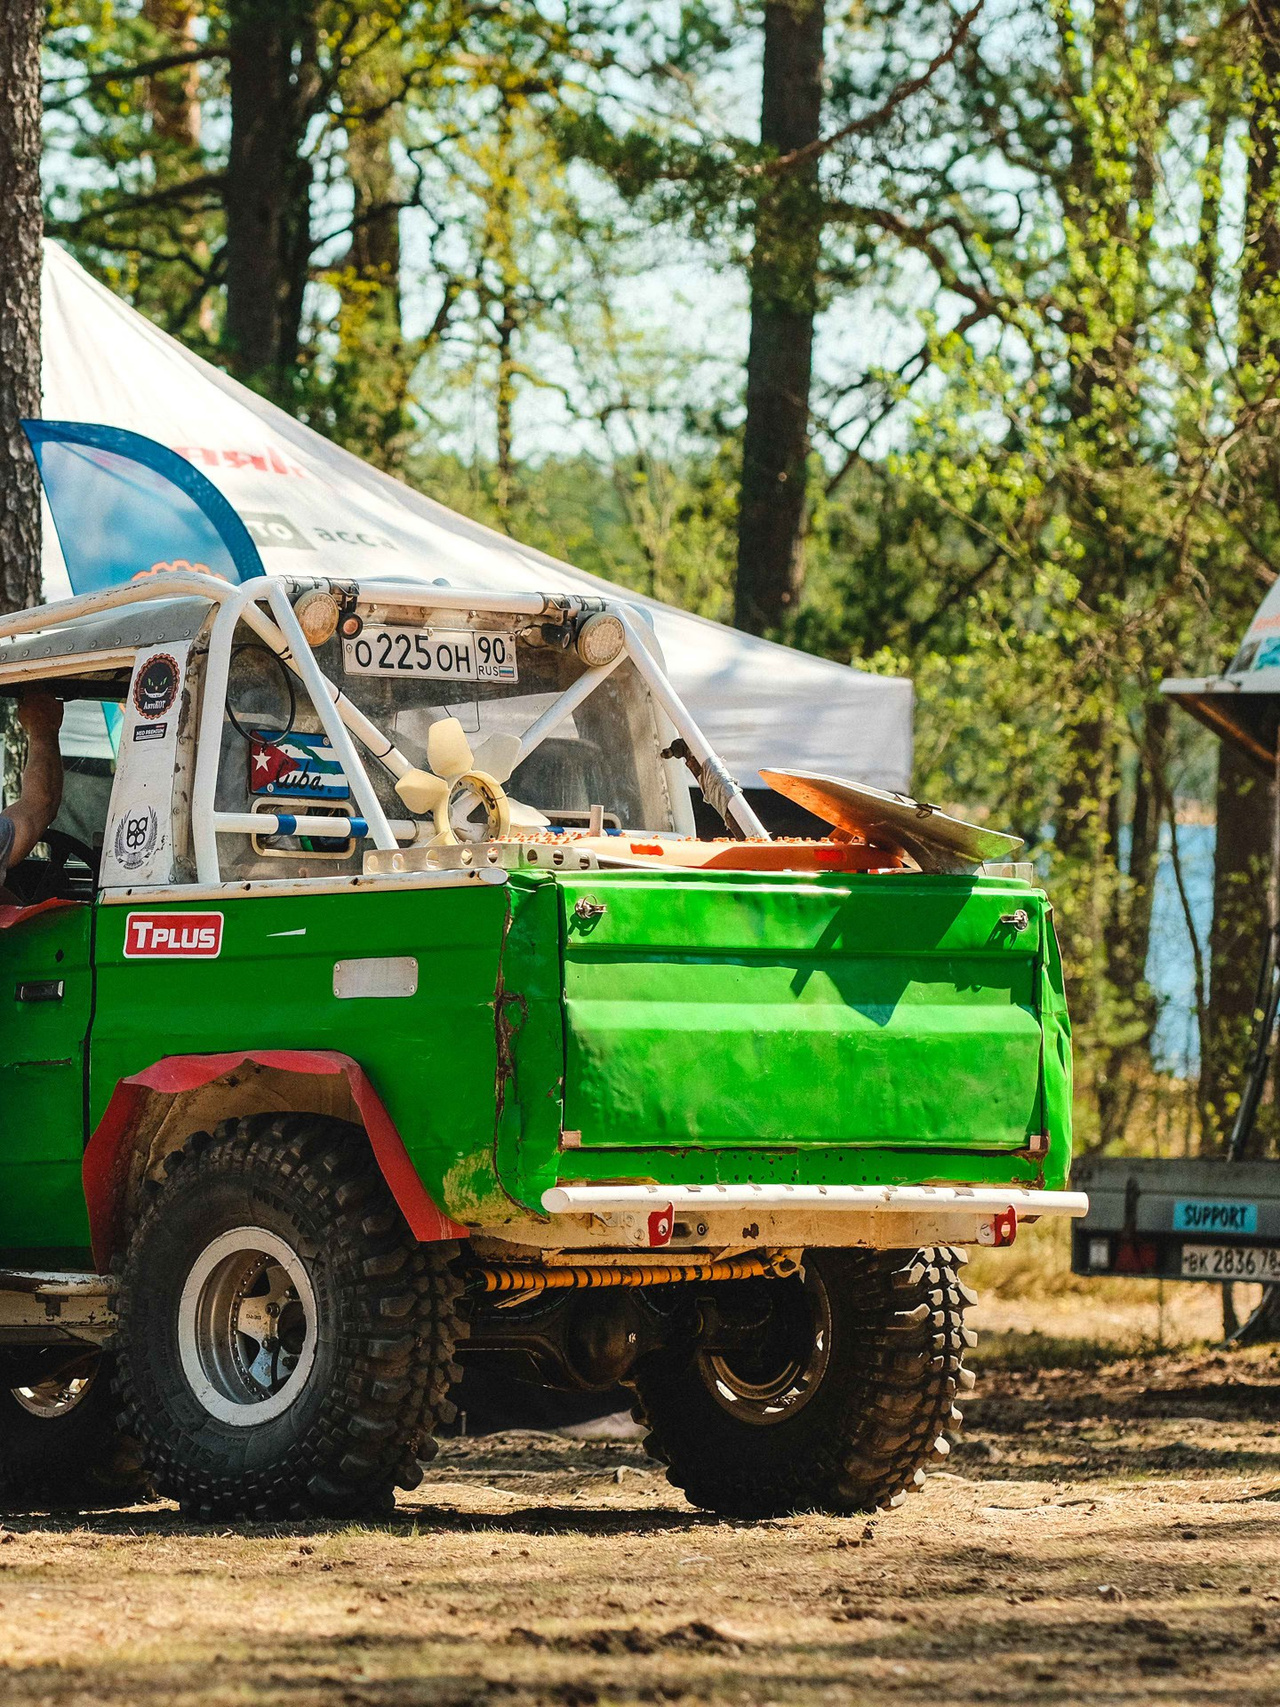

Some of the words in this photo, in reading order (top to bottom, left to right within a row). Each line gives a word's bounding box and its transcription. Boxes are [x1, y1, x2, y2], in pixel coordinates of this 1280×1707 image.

[478, 636, 505, 664] 90
[478, 666, 499, 677] RUS
[275, 759, 325, 792] Cuba
[132, 921, 216, 949] TPLUS
[1185, 1204, 1247, 1228] SUPPORT
